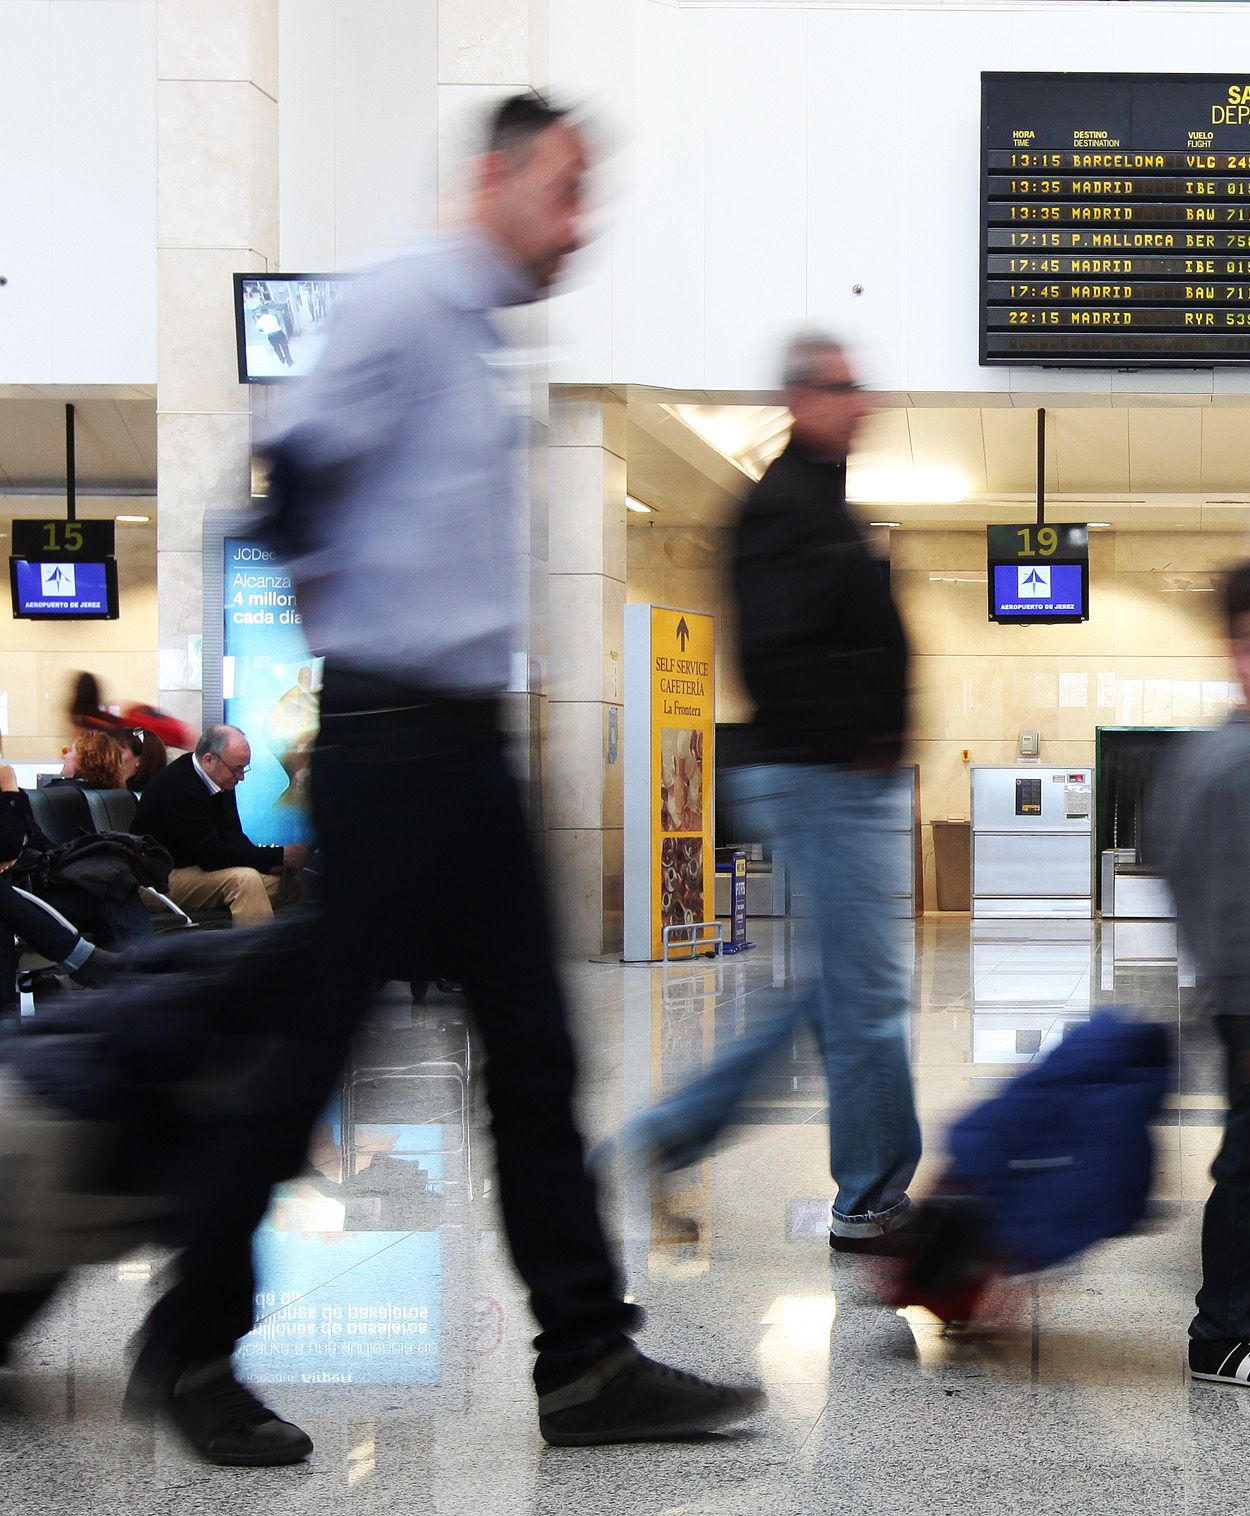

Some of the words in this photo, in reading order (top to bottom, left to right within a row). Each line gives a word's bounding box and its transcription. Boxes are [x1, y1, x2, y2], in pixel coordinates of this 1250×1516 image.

[1188, 140, 1211, 148] FLIGHT
[1010, 155, 1060, 167] 13:15
[1072, 155, 1164, 167] BARCELONA
[1186, 156, 1215, 168] VLG
[1010, 182, 1060, 193] 13:35
[1072, 182, 1132, 193] MADRID
[1186, 183, 1215, 194] IBE
[1010, 208, 1060, 219] 13:35
[1072, 208, 1132, 219] MADRID
[1186, 209, 1215, 221] BAW
[1010, 234, 1060, 246] 17:15
[1072, 234, 1174, 246] P.MALLORCA
[1186, 236, 1215, 247] BER
[1010, 260, 1059, 272] 17:45
[1072, 260, 1132, 272] MADRID
[1186, 262, 1215, 273] IBE
[1010, 286, 1059, 298] 17:45
[1072, 286, 1132, 298] MADRID
[1186, 288, 1215, 299] BAW
[1009, 312, 1059, 324] 22:15
[1072, 312, 1132, 324] MADRID
[1186, 314, 1215, 325] RYR
[42, 523, 84, 551] 15
[1017, 528, 1058, 556] 19
[233, 573, 291, 588] Alcanza
[233, 592, 243, 606] 4
[233, 609, 275, 624] cada
[656, 657, 675, 672] SELF
[677, 659, 709, 676] SERVICE
[660, 677, 705, 696] CAFETERÍA
[664, 700, 672, 714] La
[674, 701, 701, 716] Frontera
